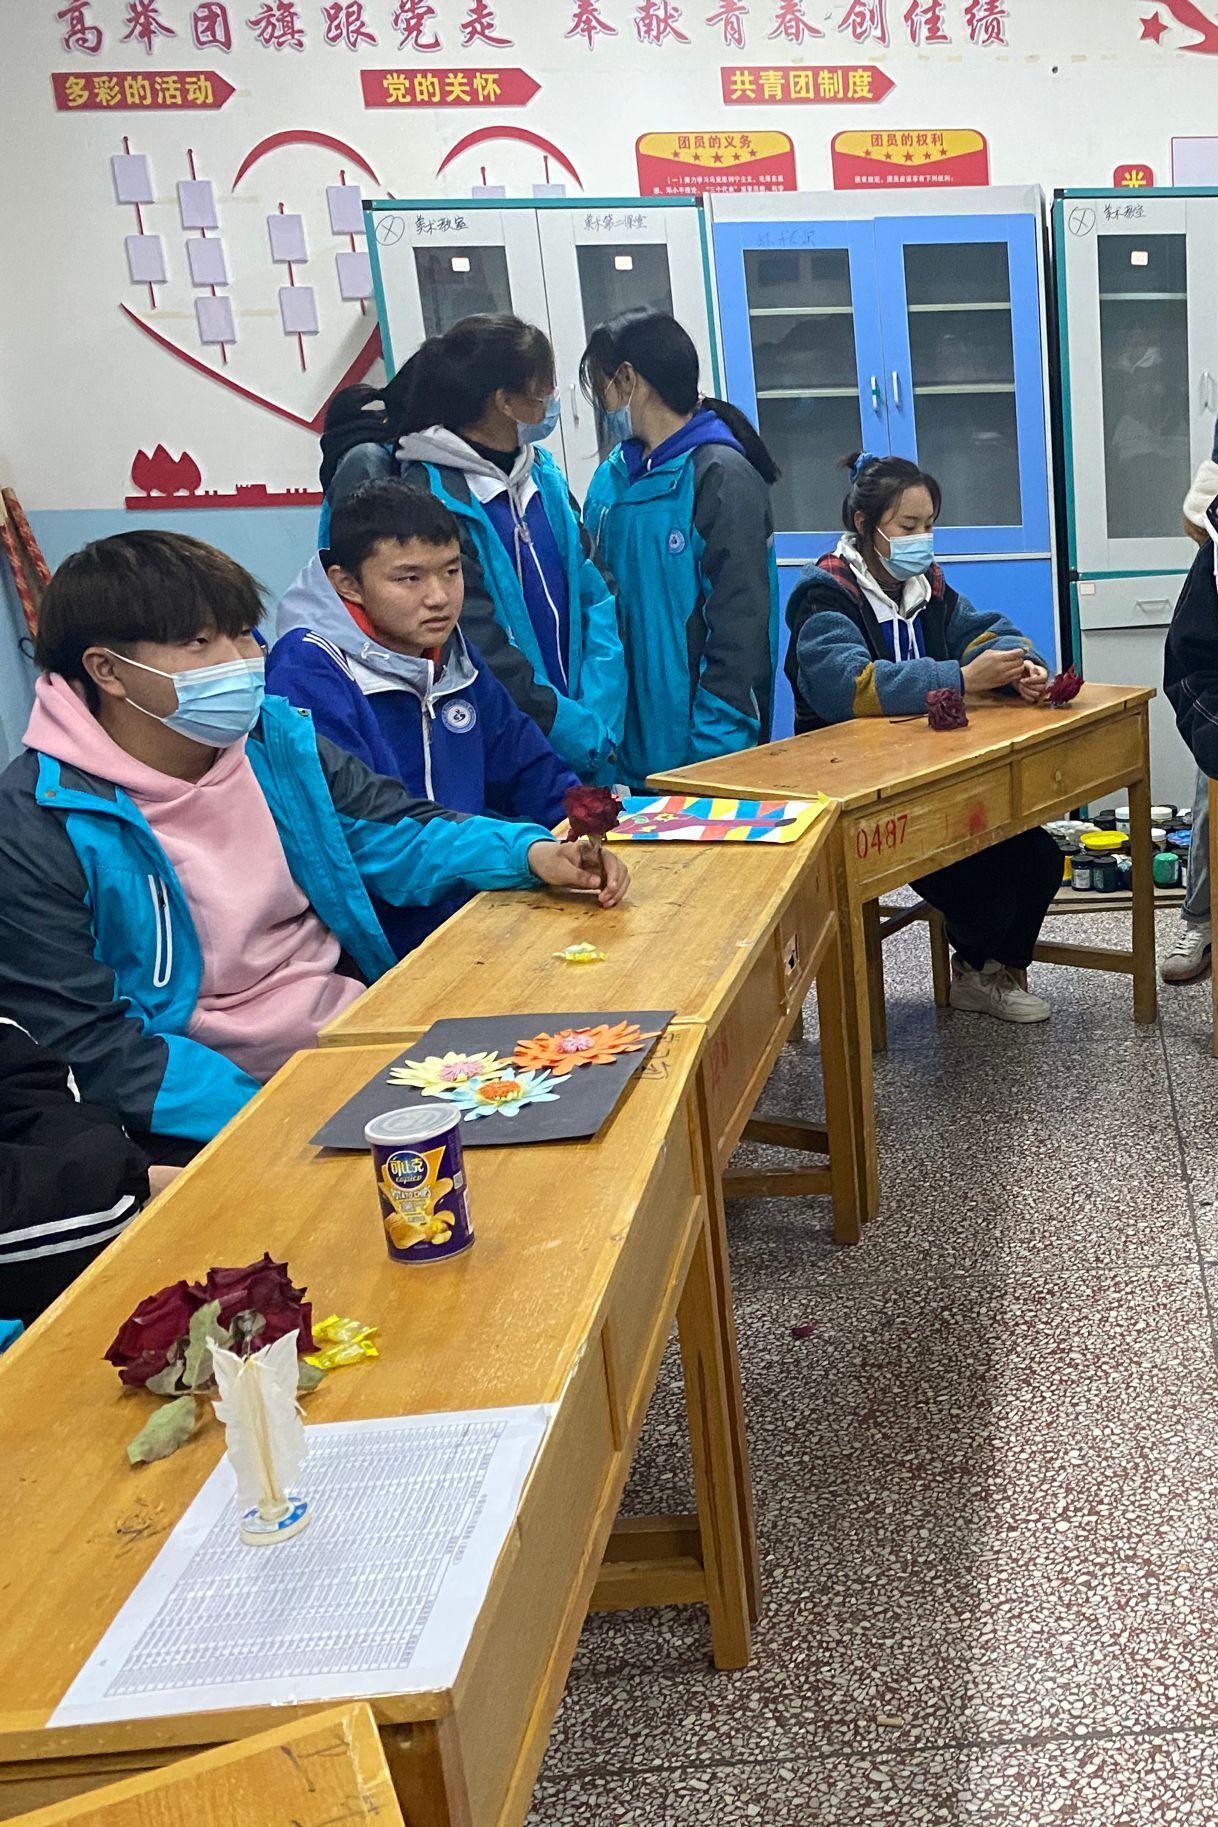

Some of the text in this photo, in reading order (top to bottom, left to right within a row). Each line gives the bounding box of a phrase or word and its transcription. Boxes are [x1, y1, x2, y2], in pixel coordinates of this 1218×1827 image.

[56, 0, 1010, 54] 高举团旗跟党走 奉献青春创佳绩
[64, 73, 215, 106] 多彩的活动
[381, 69, 503, 104] 党的关怀
[729, 67, 875, 102] 共青团制度
[677, 134, 753, 151] 团员的义务
[870, 132, 945, 148] 团员的权利
[855, 813, 909, 860] 0487
